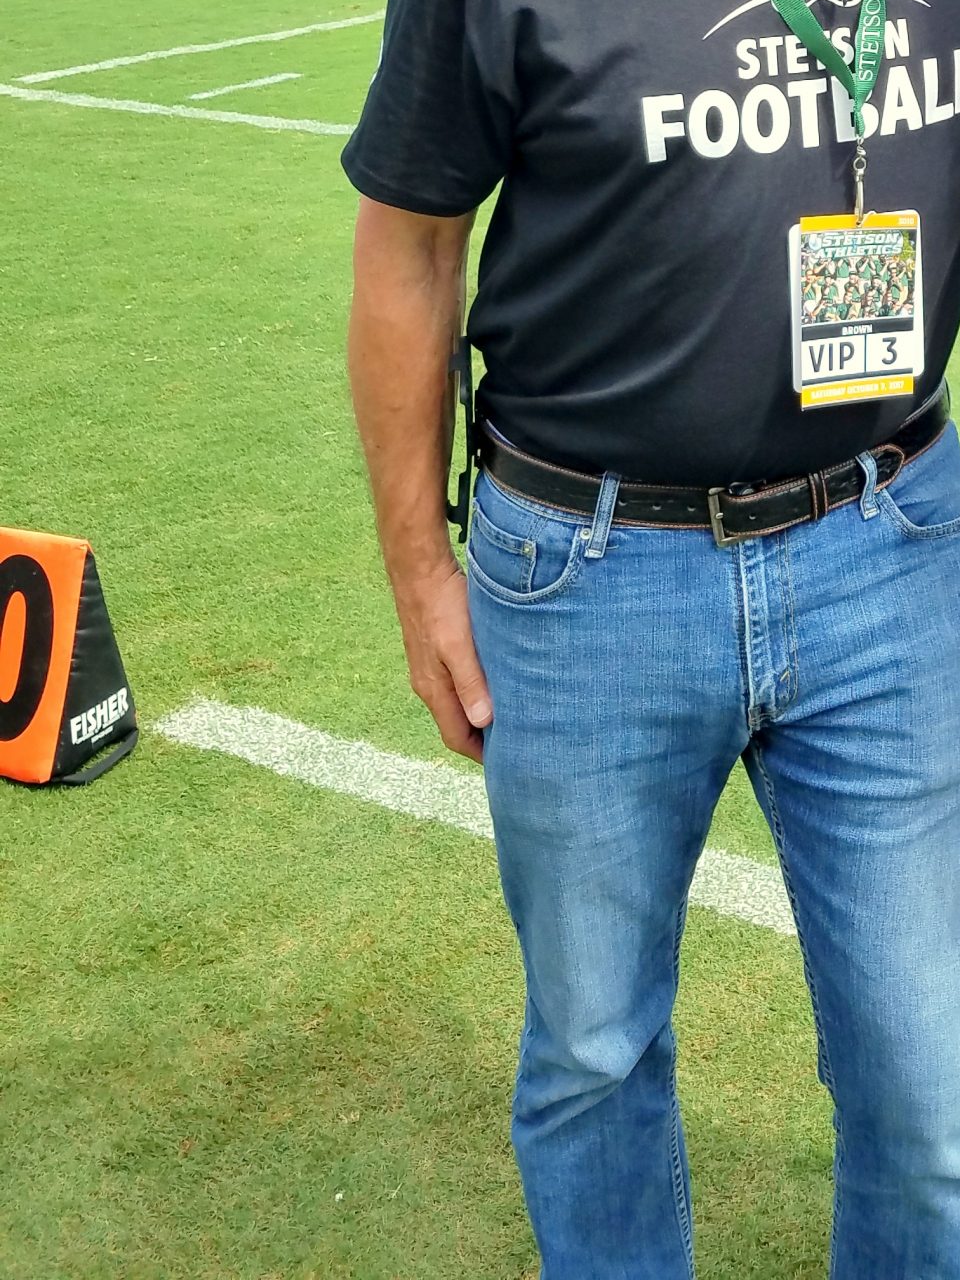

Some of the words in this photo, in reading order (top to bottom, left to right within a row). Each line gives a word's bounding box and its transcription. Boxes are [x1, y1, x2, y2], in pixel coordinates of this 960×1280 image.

[820, 232, 901, 247] STETSON
[815, 244, 901, 259] ATHLETICS
[842, 324, 873, 336] BROWN
[808, 341, 855, 373] VIP
[881, 336, 898, 365] 3
[70, 687, 129, 745] FISHER
